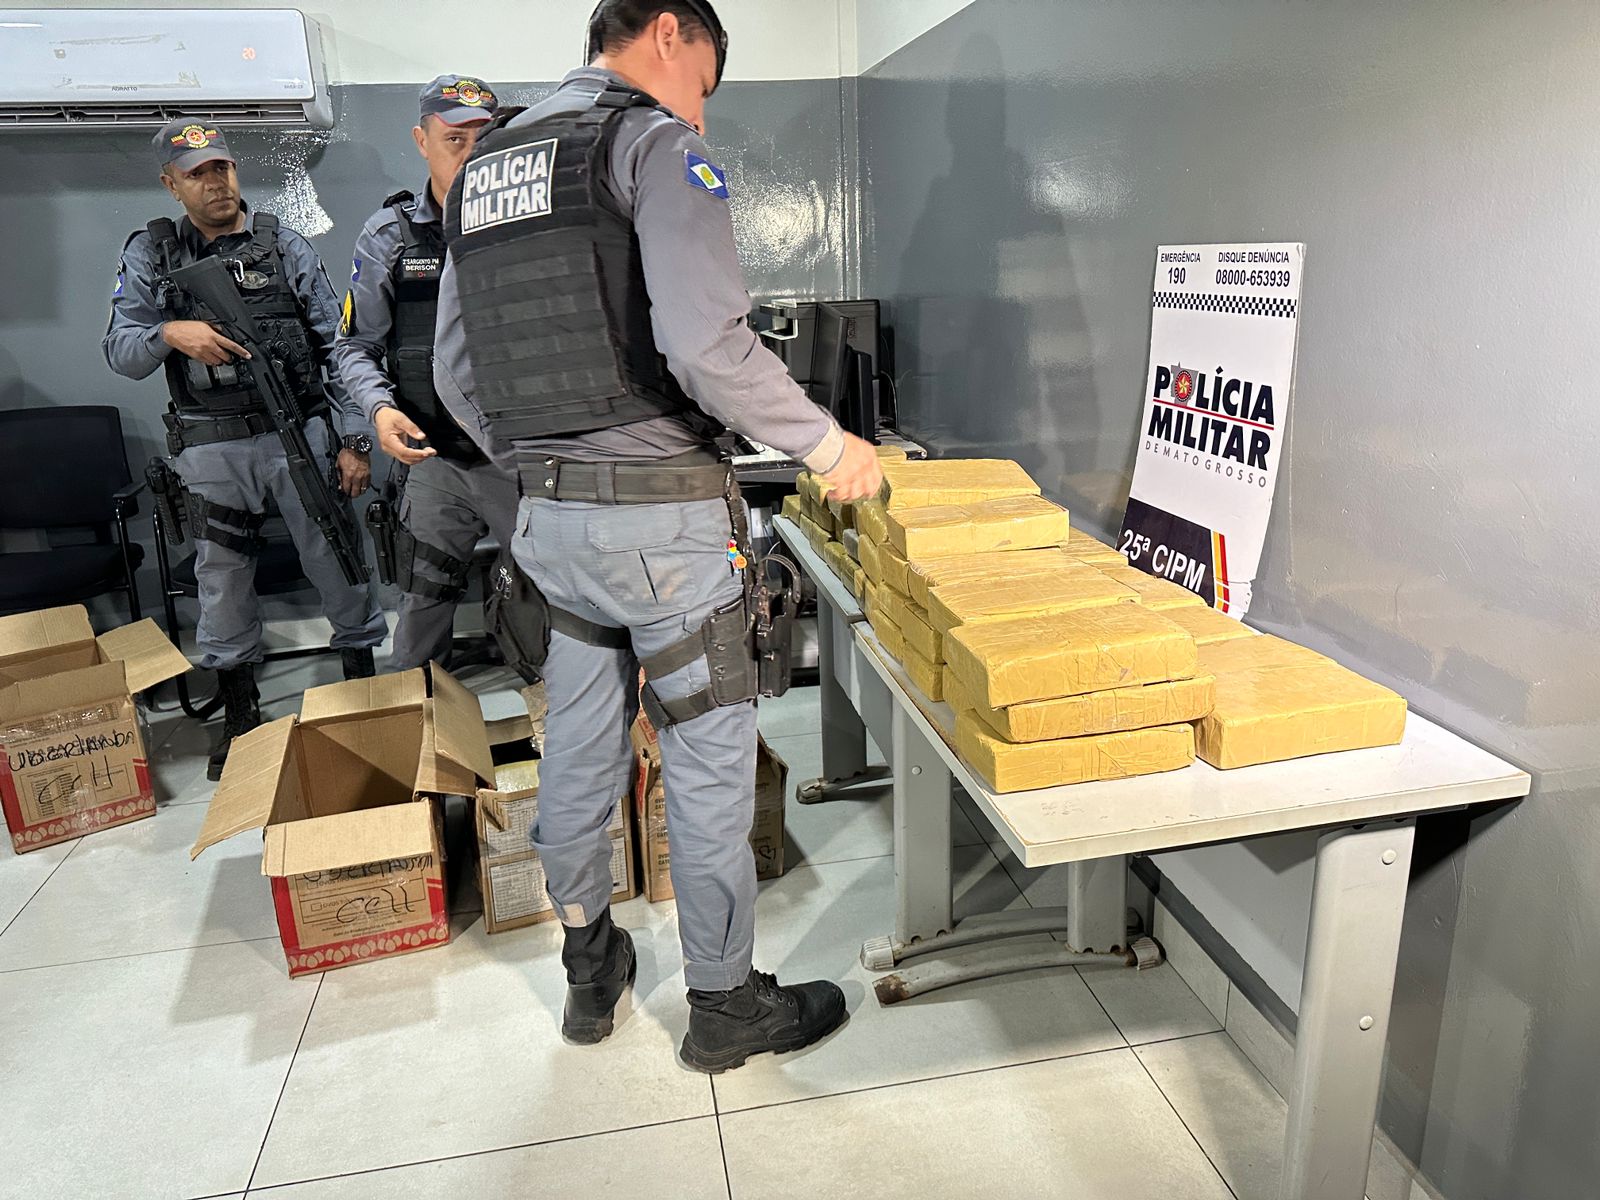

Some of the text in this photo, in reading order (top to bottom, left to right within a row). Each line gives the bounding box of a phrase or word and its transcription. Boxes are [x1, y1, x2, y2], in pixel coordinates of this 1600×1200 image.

[242, 47, 256, 60] 20
[465, 151, 548, 196] POLÍCIA
[464, 181, 548, 229] MILITAR
[1160, 250, 1201, 262] EMERGÊNCIA
[1218, 248, 1290, 263] DISQUE DENÚNCIA
[1168, 266, 1187, 284] 190
[1215, 269, 1291, 287] 08000-653939
[1148, 405, 1271, 471] MILITAR
[1205, 459, 1267, 488] GROSSO
[1152, 544, 1207, 593] CIPM
